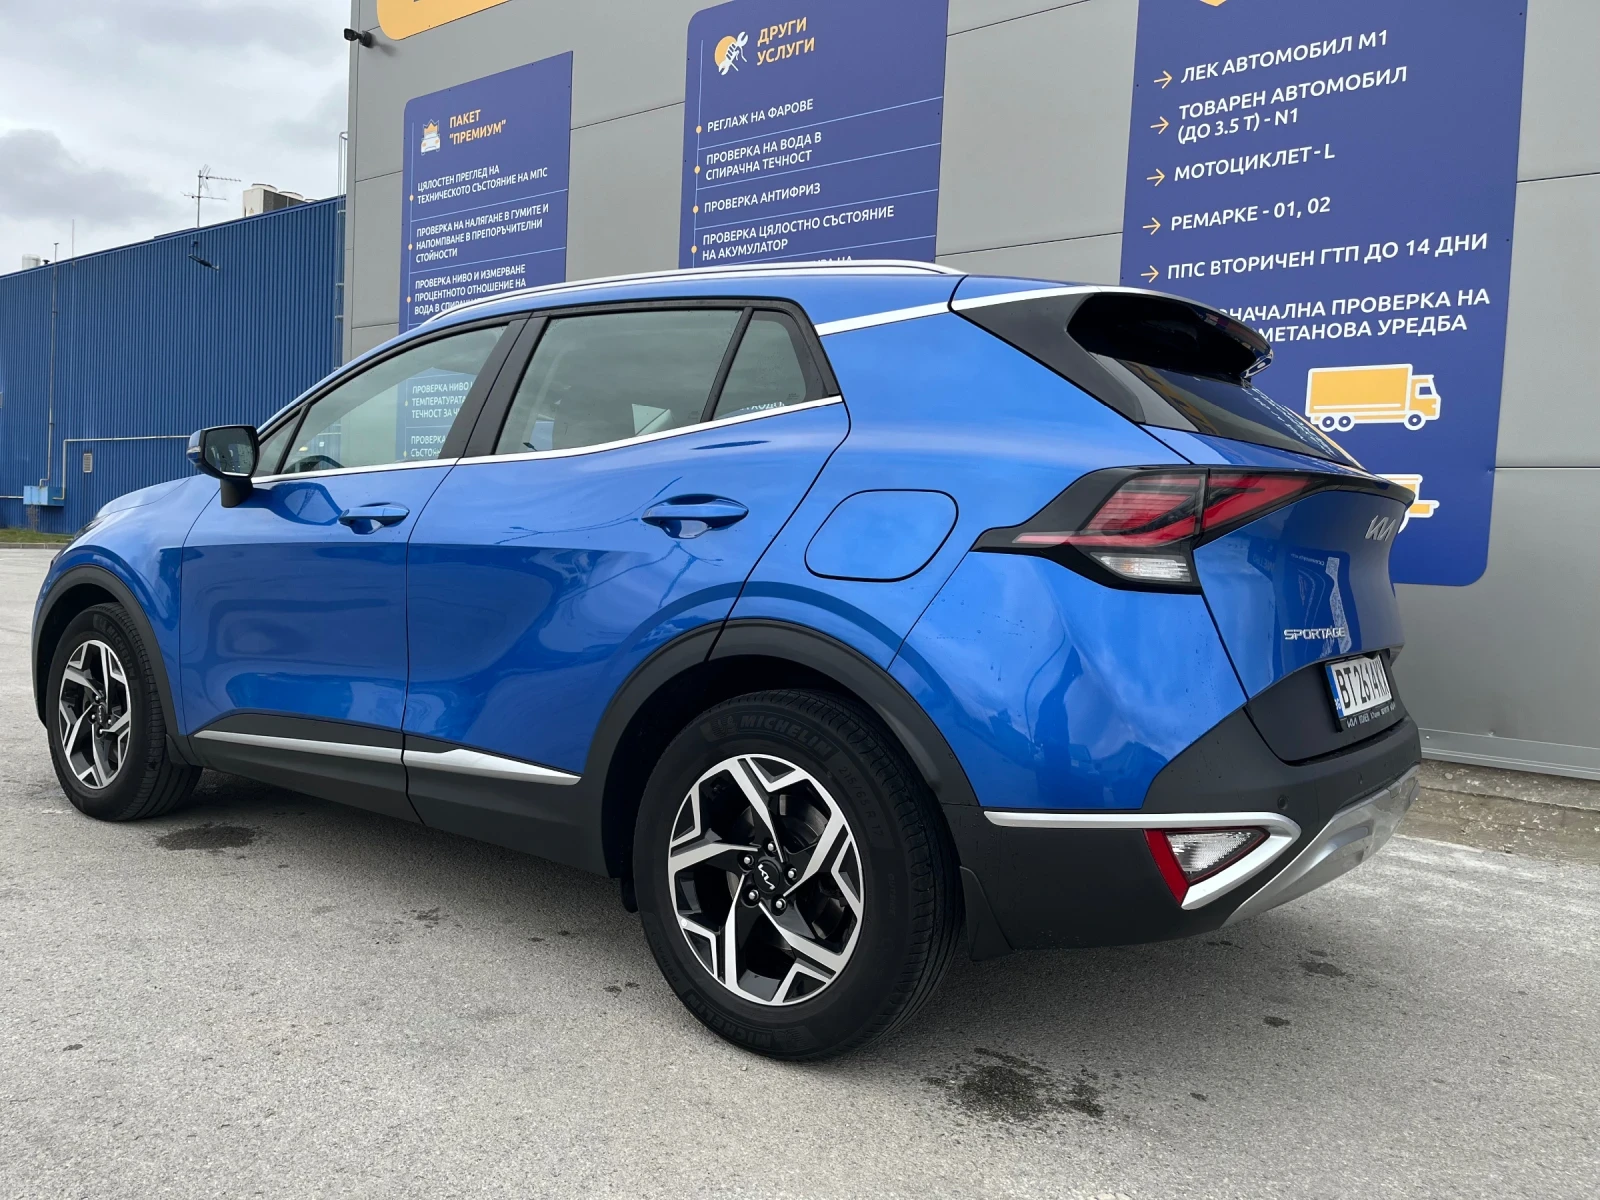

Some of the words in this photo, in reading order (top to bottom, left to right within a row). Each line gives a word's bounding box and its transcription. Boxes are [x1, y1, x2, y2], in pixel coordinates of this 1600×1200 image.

[757, 17, 806, 47] ДРУГИ
[757, 37, 814, 66] УСЛУГИ
[1181, 62, 1218, 83] ЛЕК
[1222, 36, 1352, 75] АВТОМОБИЛ
[1179, 90, 1266, 120] ТОВАРЕН
[1270, 66, 1406, 104] АВТОМОБИЛ
[450, 109, 481, 128] ПАКЕТ
[708, 113, 748, 132] РЕГЛАЖ
[751, 110, 765, 122] НА
[768, 98, 813, 118] ФАРОВЕ
[1178, 123, 1210, 144] (ДО
[1214, 118, 1239, 136] 3.5
[1275, 108, 1297, 126] N1
[707, 145, 760, 165] ПРОВЕРКА
[763, 141, 778, 154] НА
[780, 134, 812, 150] ВОДА
[815, 132, 821, 143] В
[1324, 144, 1335, 159] L
[418, 175, 454, 192] ЦЯЛОСТЕН
[456, 167, 488, 183] ПРЕГЛЕД
[489, 165, 500, 175] НА
[706, 160, 760, 180] СПИРАЧНА
[762, 150, 812, 169] ТЕЧНОСТ
[417, 185, 470, 204] ТЕХНИЧЕСКОТО
[472, 174, 516, 192] СЪСТОЯНИЕ
[517, 172, 528, 182] НА
[530, 167, 548, 180] МПС
[704, 194, 758, 213] ПРОВЕРКА
[760, 183, 820, 203] АНТИФРИЗ
[417, 223, 452, 237] ПРОВЕРКА
[454, 220, 464, 230] НА
[465, 212, 503, 228] НАЛЯГАНЕ
[504, 211, 509, 220] В
[511, 205, 541, 219] ГУМИТЕ
[543, 203, 548, 213] И
[703, 227, 756, 245] ПРОВЕРКА
[759, 217, 820, 238] ЦЯЛОСТНО
[823, 205, 894, 227] СЪСТОЯНИЕ
[1171, 206, 1258, 230] РЕМАРКЕ
[416, 233, 464, 250] НАПОМПВАНЕ
[466, 232, 470, 241] В
[472, 218, 542, 240] ПРЕПОРЪЧИТЕЛНИ
[702, 249, 716, 260] НА
[718, 238, 788, 258] АКУМУЛАТОР
[416, 248, 458, 263] СТОЙНОСТИ
[1168, 262, 1205, 279] ППС
[1210, 250, 1314, 275] ВТОРИЧЕН
[1321, 246, 1359, 264] ГТП
[1364, 242, 1398, 264] ДО
[1406, 238, 1430, 256] 14
[1435, 233, 1487, 257] ДНИ
[415, 276, 451, 289] ПРОВЕРКА
[452, 272, 472, 284] НИВО
[474, 271, 479, 280] И
[481, 264, 525, 279] ИЗМЕРВАНЕ
[415, 286, 466, 302] ПРОЦЕНТНОТО
[467, 279, 514, 294] ОТНОШЕНИЕ
[515, 278, 526, 288] НА
[414, 303, 434, 316] ВОДА
[1331, 291, 1451, 316] ПРОВЕРКА
[1457, 288, 1490, 306] НА
[1377, 314, 1468, 336] УРЕДБА
[1283, 626, 1346, 640] SPORTAGE
[740, 715, 832, 758] MICHELIN
